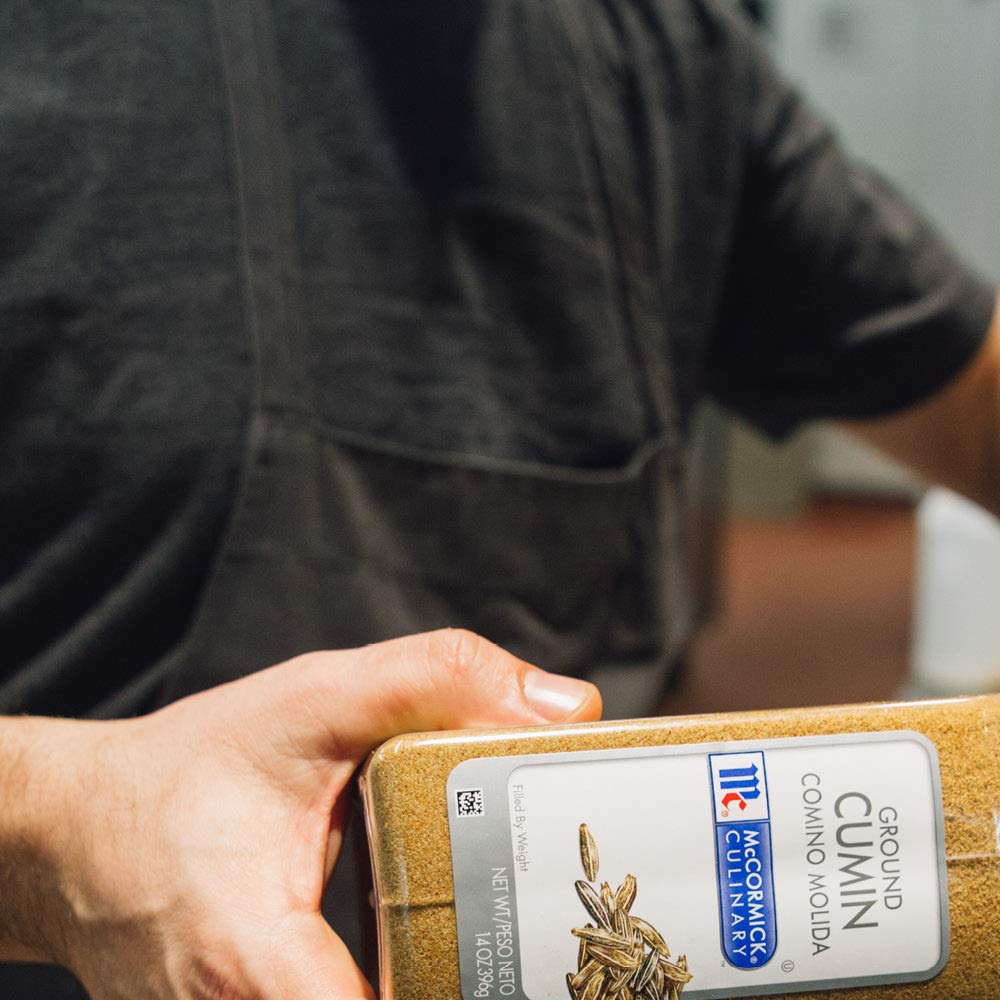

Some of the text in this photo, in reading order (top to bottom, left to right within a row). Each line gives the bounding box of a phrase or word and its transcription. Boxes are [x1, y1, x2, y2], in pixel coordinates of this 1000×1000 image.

[491, 868, 508, 892] NET
[513, 784, 530, 872] Filled By Weight
[801, 773, 830, 956] COMINO MOLIDA
[834, 792, 878, 930] CUMIN
[878, 806, 902, 910] GROUND
[725, 830, 747, 956] CULINARY
[498, 961, 515, 995] NETO
